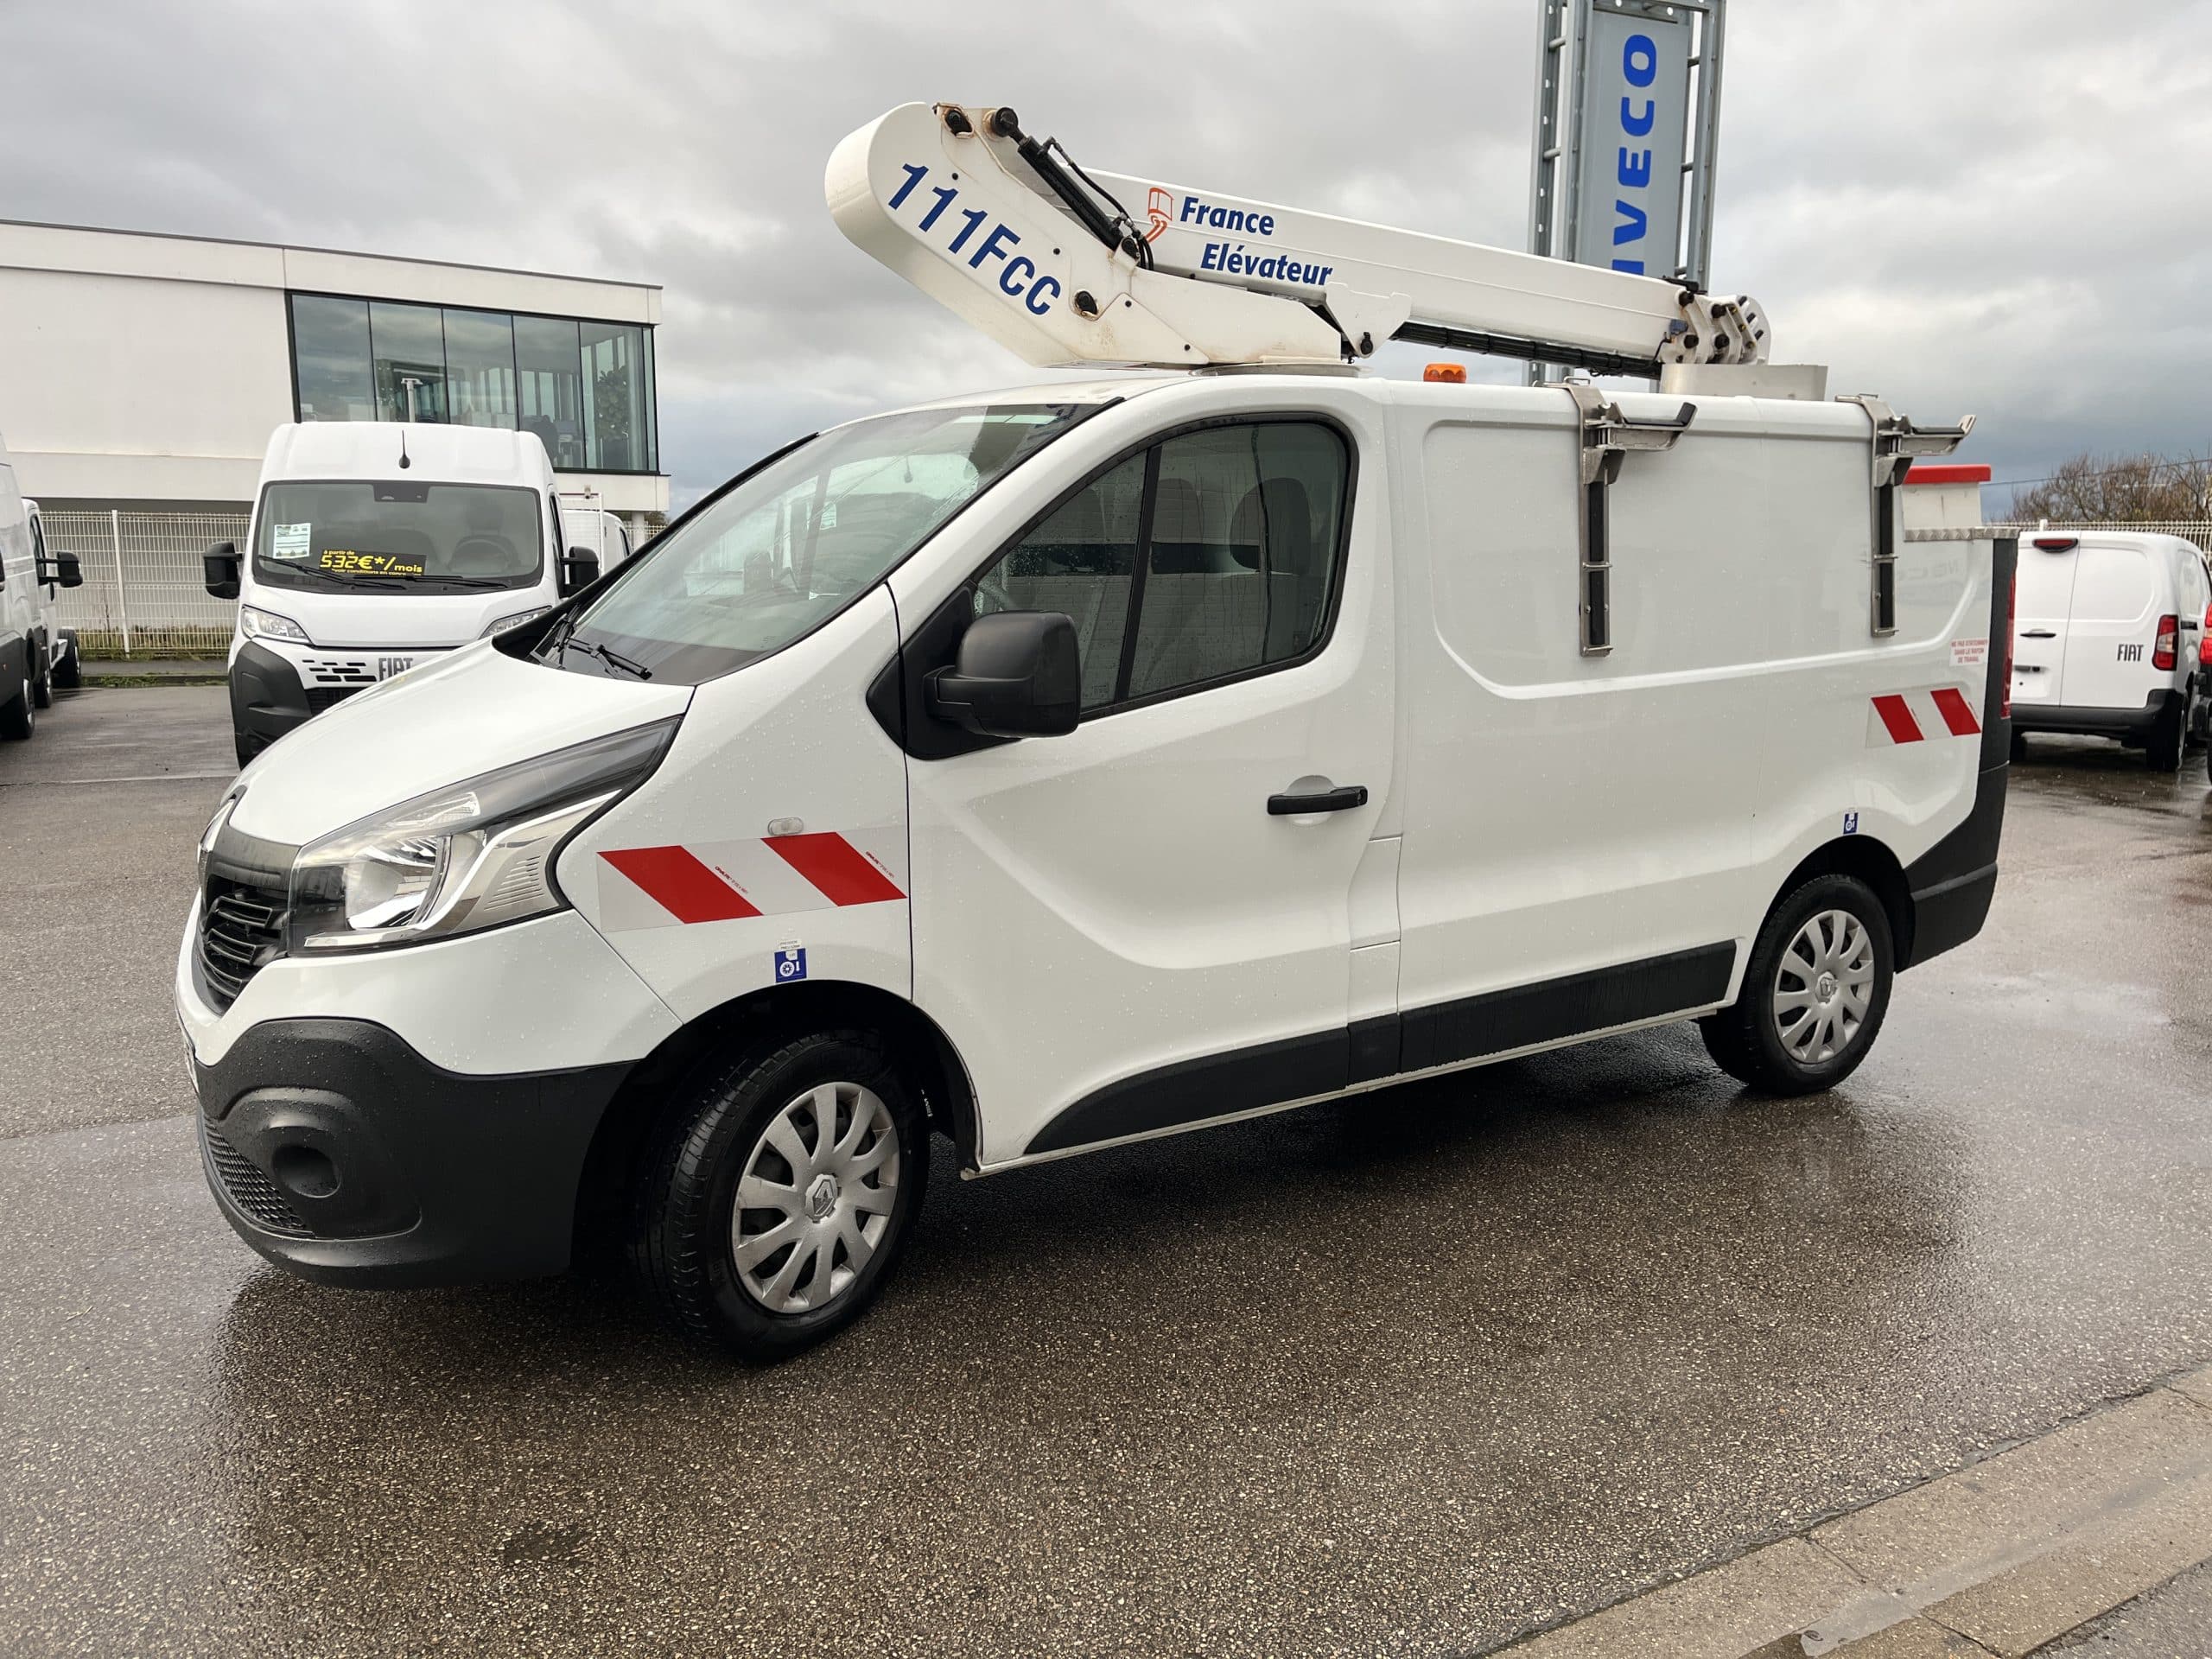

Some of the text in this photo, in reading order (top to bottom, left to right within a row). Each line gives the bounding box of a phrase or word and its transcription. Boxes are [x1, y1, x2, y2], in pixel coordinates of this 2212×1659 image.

[1612, 34, 1656, 275] IVECO
[1180, 196, 1274, 235] France
[888, 163, 1061, 315] 111FCC
[1200, 243, 1333, 286] Elévateur
[2117, 644, 2144, 662] FIAT
